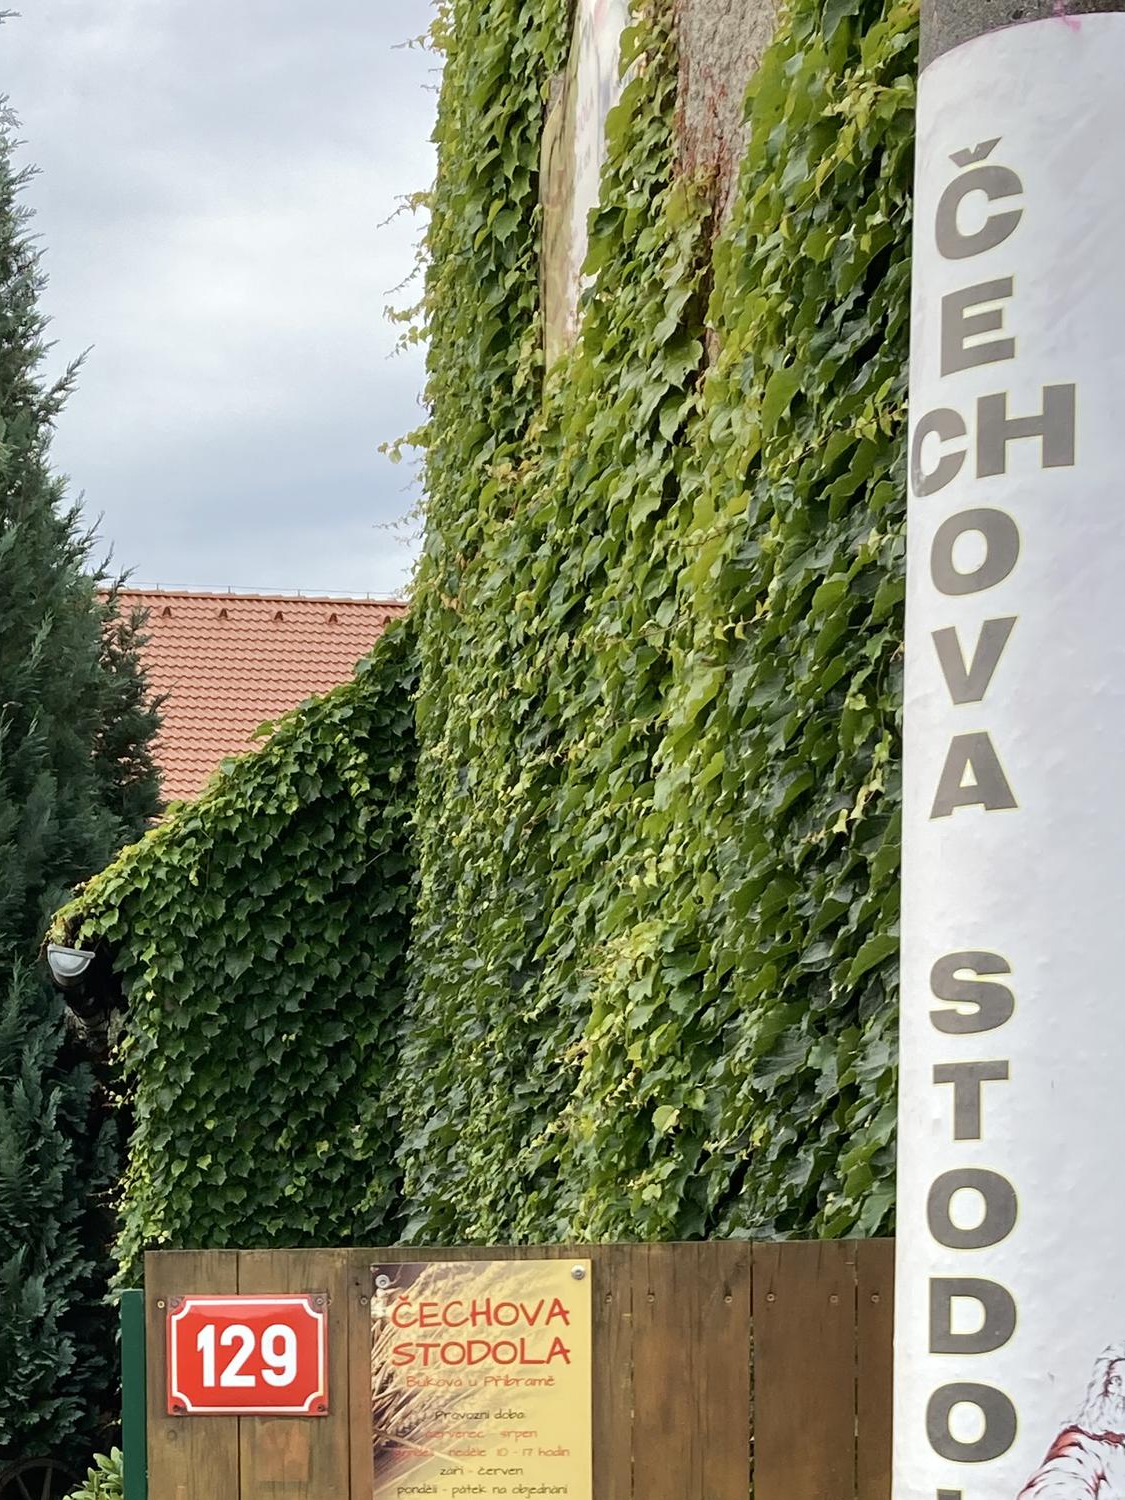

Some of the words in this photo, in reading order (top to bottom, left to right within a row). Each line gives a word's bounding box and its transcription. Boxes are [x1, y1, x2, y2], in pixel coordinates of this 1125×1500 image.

[910, 136, 1075, 820] ČECHOVA
[391, 1296, 570, 1328] ČECHOVA
[197, 1324, 297, 1387] 129
[391, 1337, 571, 1366] STODOLA
[469, 1378, 477, 1387] u
[538, 1446, 570, 1458] hodin
[396, 1484, 437, 1498] pondělí
[451, 1484, 487, 1498] pátek
[492, 1486, 507, 1495] na
[512, 1483, 568, 1498] objednání
